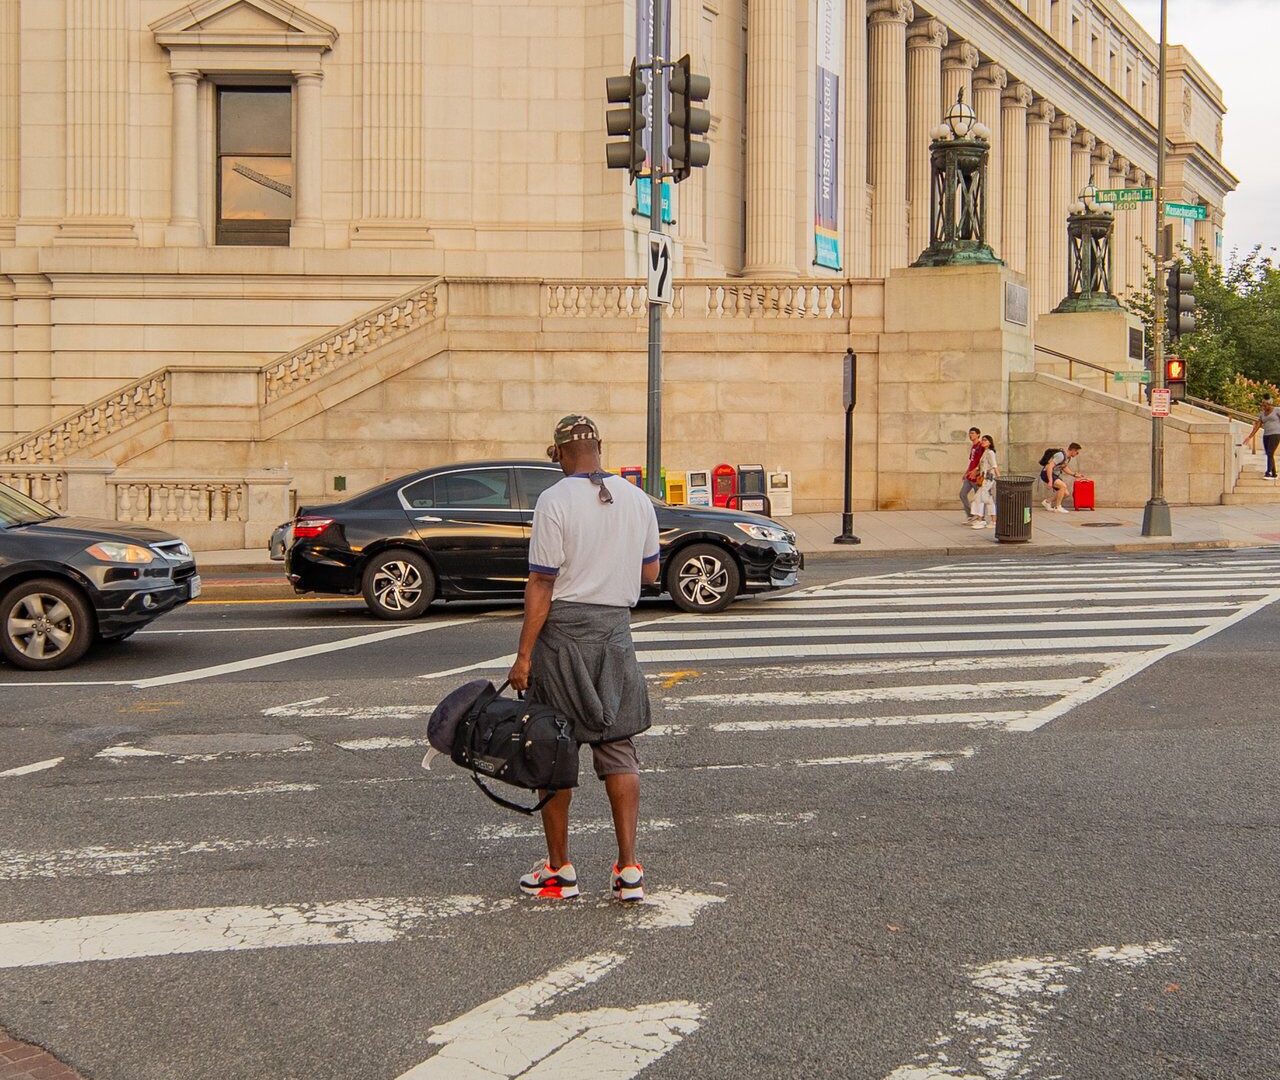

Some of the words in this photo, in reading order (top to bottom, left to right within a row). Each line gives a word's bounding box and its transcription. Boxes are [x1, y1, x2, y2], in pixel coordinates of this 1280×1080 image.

[823, 76, 831, 131] POSTAL
[822, 134, 831, 200] MUSEUM
[1099, 191, 1117, 202] North
[1119, 190, 1143, 202] Capitol
